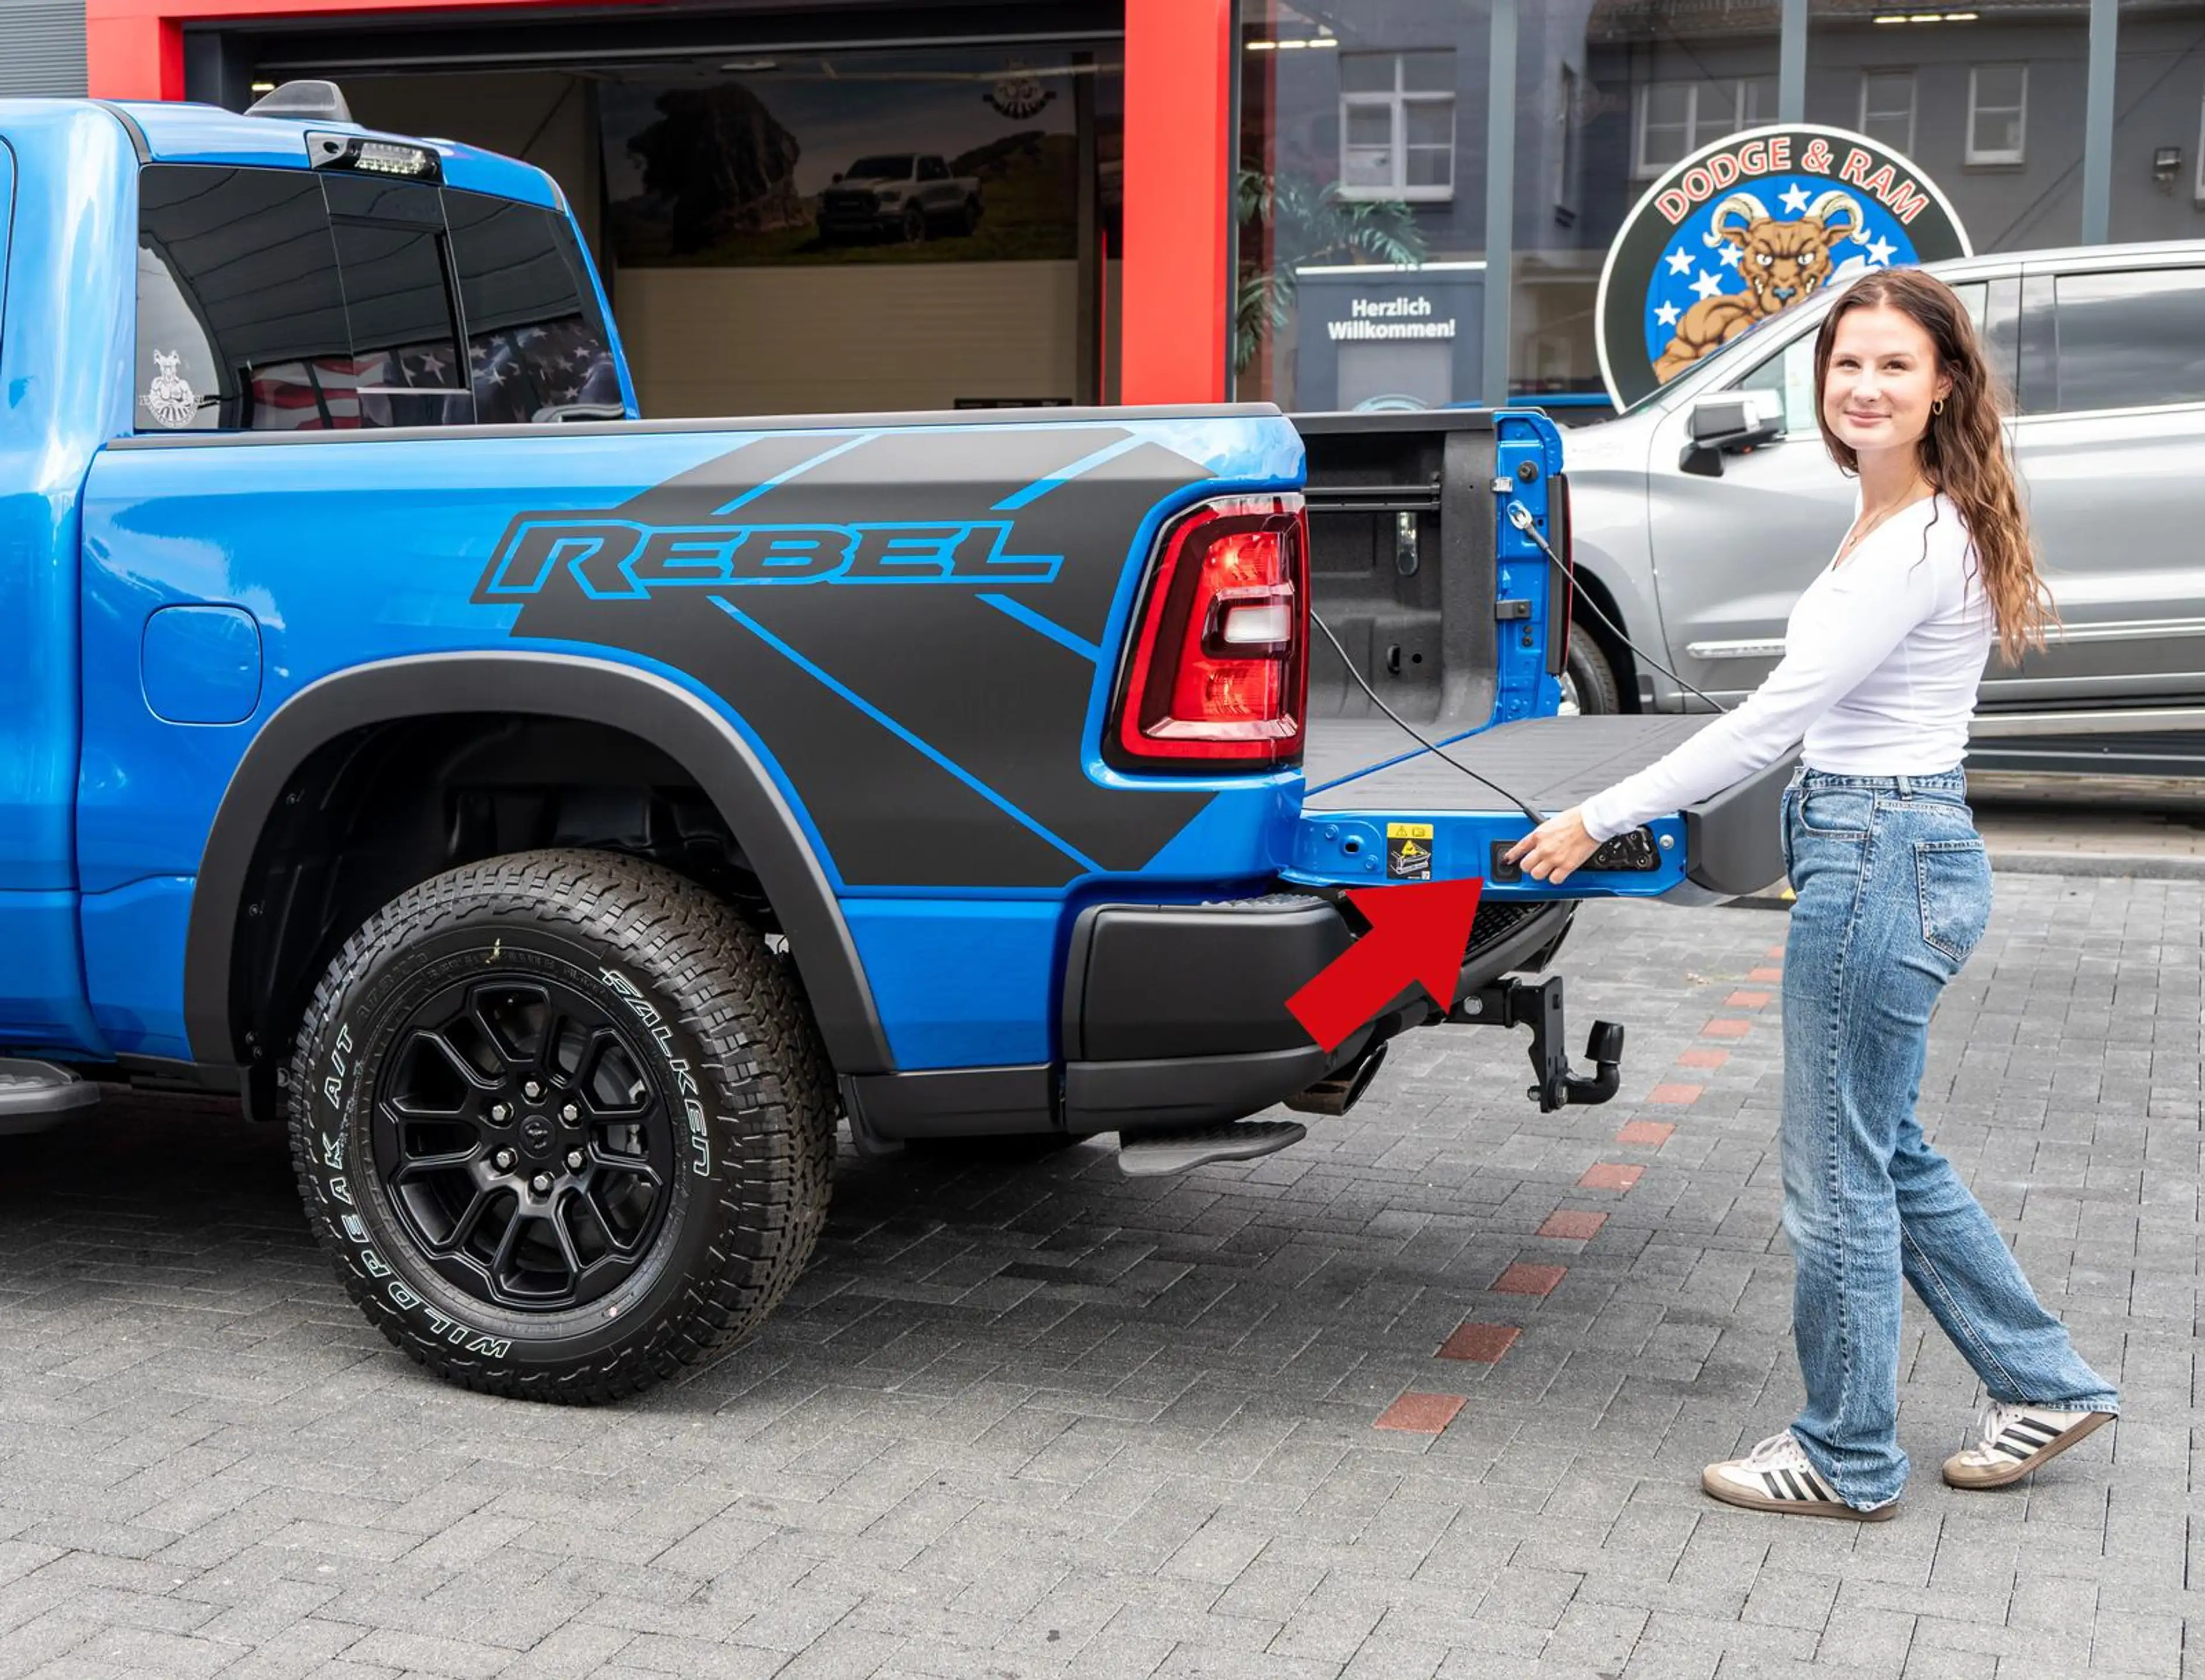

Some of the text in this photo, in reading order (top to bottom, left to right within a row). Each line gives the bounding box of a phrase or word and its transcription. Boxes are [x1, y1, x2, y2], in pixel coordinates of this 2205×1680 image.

[1654, 137, 1930, 225] DODGE & RAM
[1327, 318, 1456, 340] Willkommen!
[1351, 296, 1432, 317] Herzlich
[485, 519, 1065, 600] REBEL
[598, 967, 711, 1177] FALKEN
[321, 1023, 512, 1359] WILDPEAK A/T
